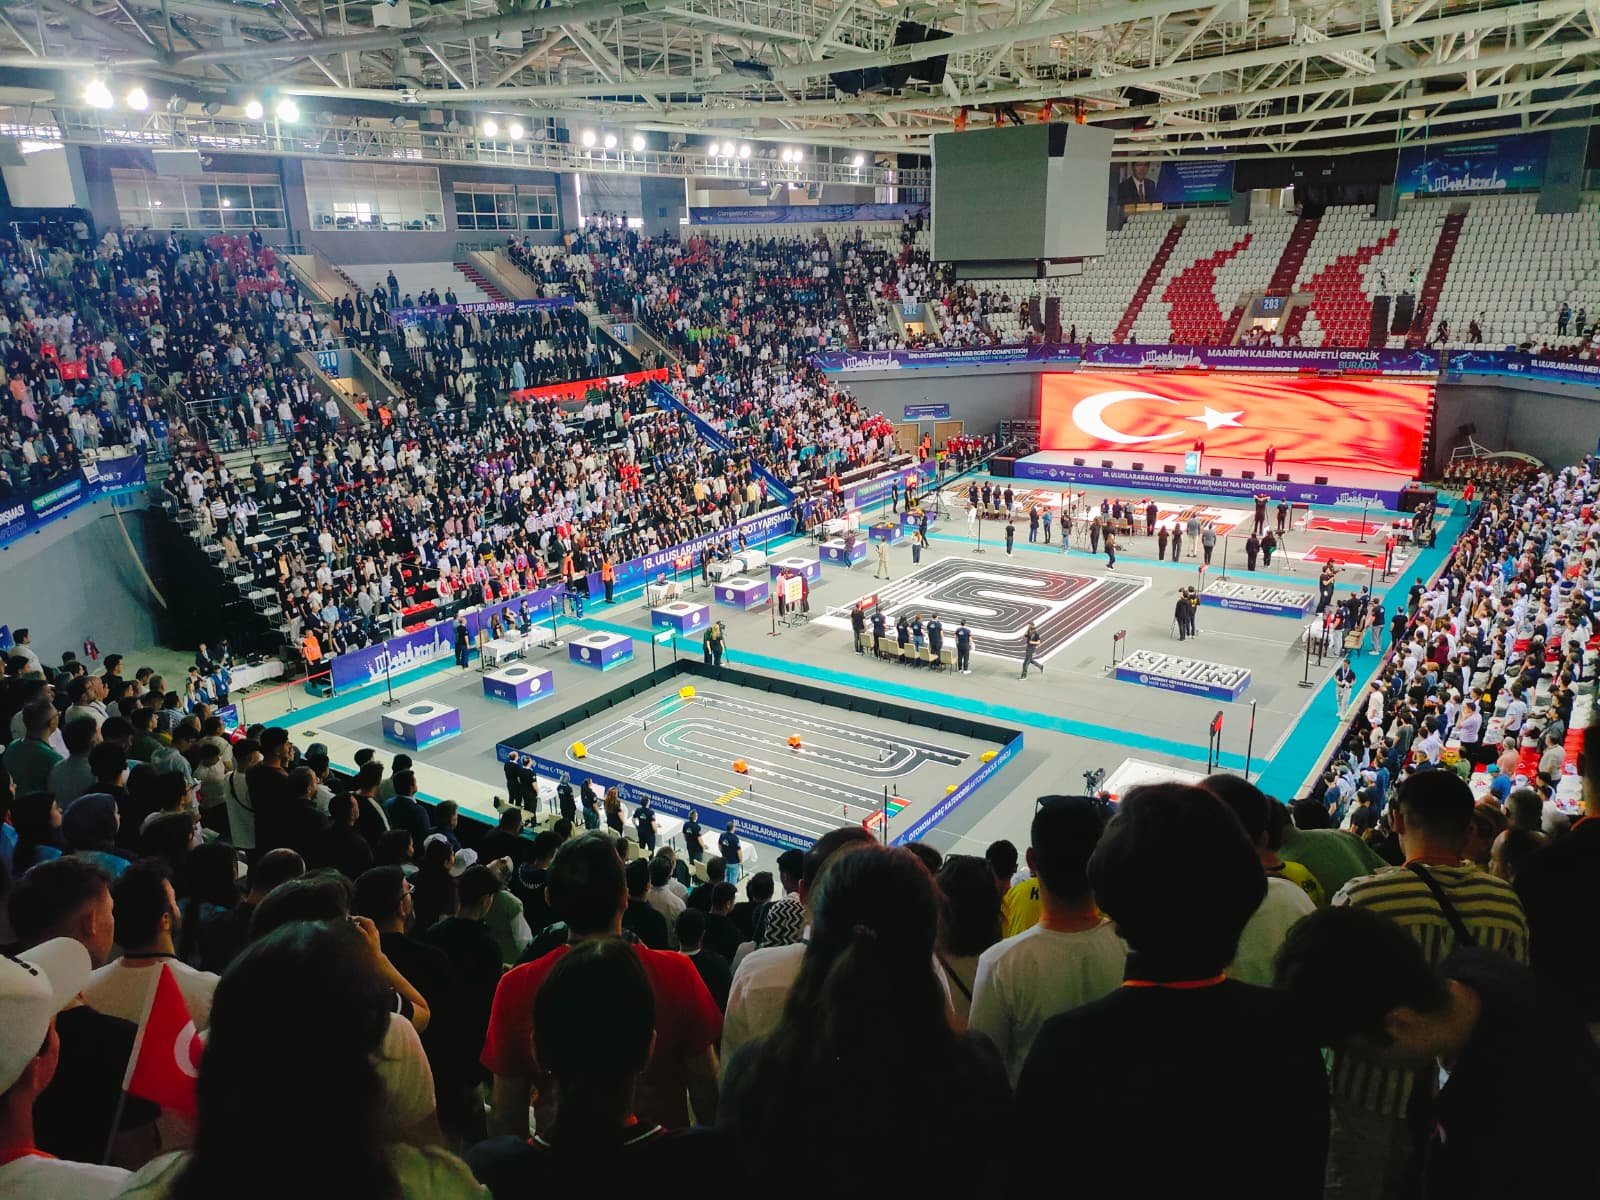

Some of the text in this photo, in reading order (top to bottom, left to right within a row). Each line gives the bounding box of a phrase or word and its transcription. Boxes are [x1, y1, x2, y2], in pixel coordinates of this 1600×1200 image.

[1263, 298, 1279, 310] 203
[318, 351, 338, 367] 210
[920, 351, 961, 359] INTERNATIONAL
[992, 348, 1028, 356] COMPETITION
[1207, 348, 1380, 363] MAARİFİN KALBİNDE MARİFETLİ GENÇLİK
[1338, 361, 1379, 370] BURADA
[1538, 360, 1584, 372] ULUSLARARASI
[1111, 472, 1155, 482] ULUSLARARASI
[1170, 477, 1192, 485] ROBOT
[1193, 478, 1240, 489] YARIŞMASI'NA
[1240, 482, 1287, 492] HOŞGELDİNİZ
[643, 557, 656, 570] 18.
[732, 523, 758, 540] ROOT
[757, 511, 792, 531] YARIŞMAS
[908, 817, 932, 841] OTONOM
[931, 805, 946, 822] ARAÇ
[741, 820, 789, 842] ULUSLARARASI
[788, 835, 804, 847] MEB
